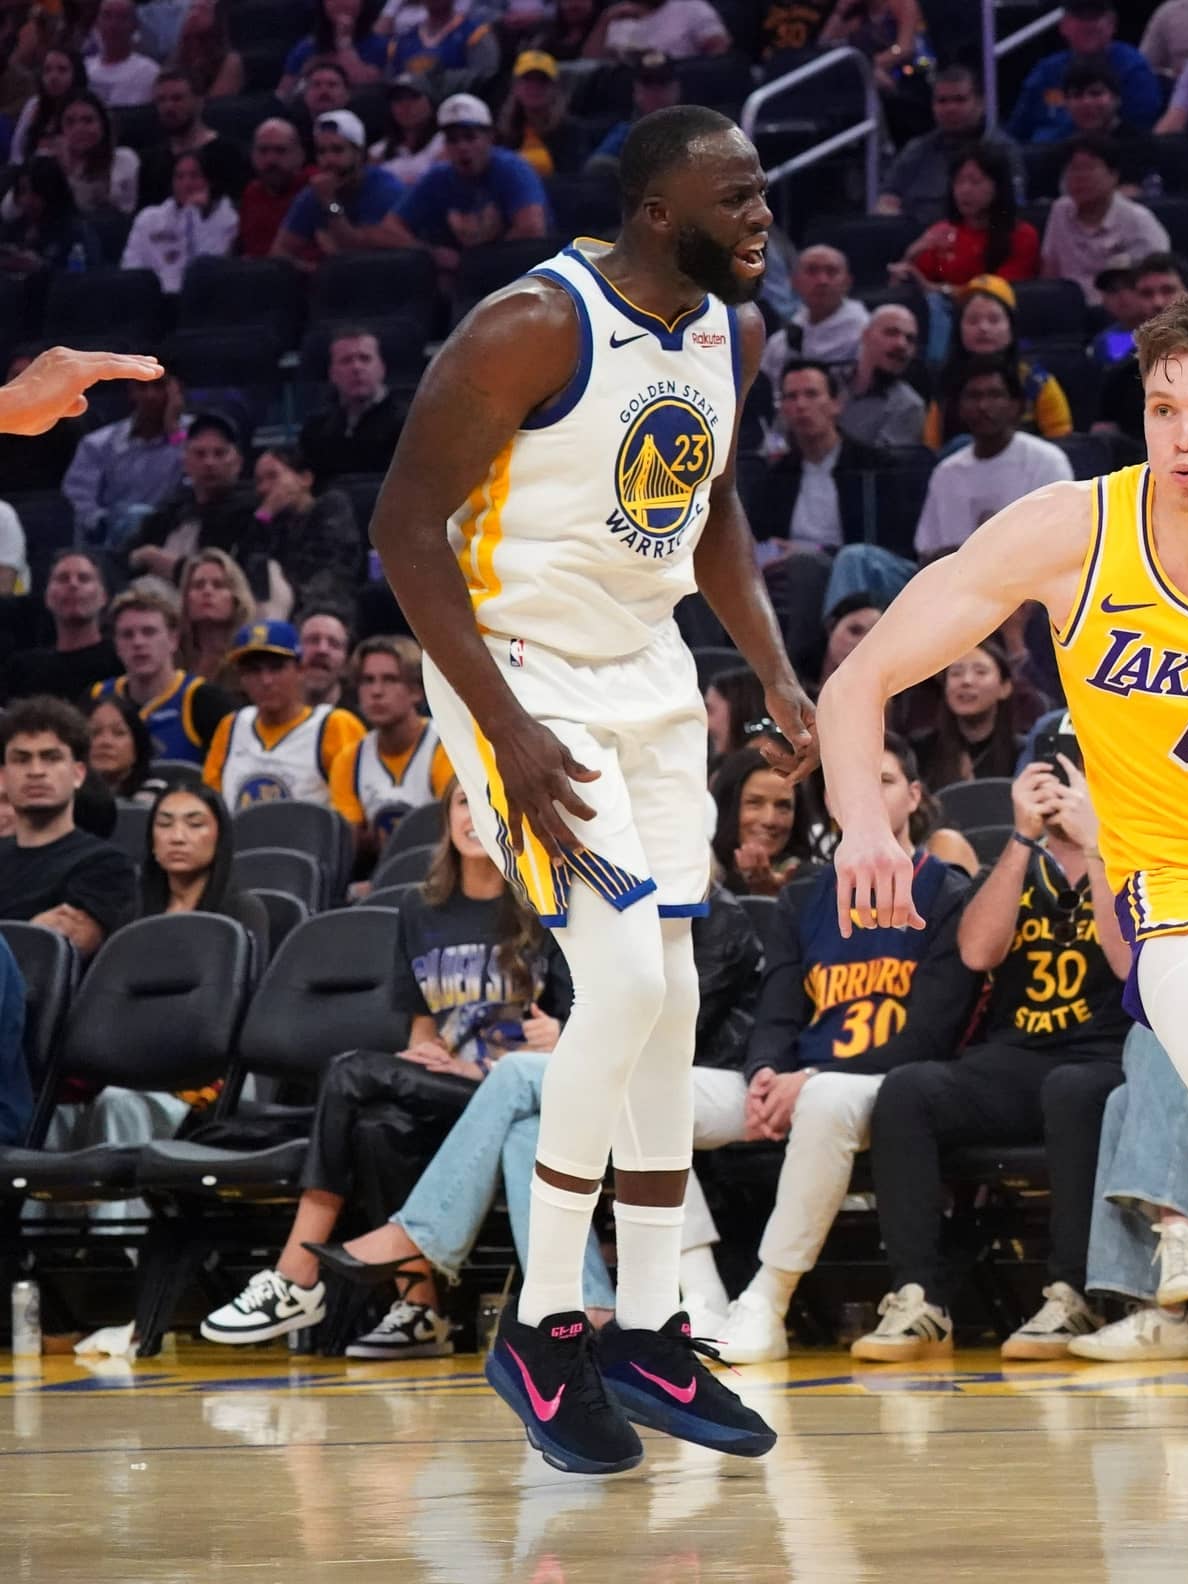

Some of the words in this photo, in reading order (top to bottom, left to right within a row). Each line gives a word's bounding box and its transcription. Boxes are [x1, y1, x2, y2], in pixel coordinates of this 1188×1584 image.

[692, 332, 726, 346] Rakuten
[620, 380, 677, 423] GOLDEN
[683, 385, 719, 427] STATE
[670, 434, 707, 472] 23
[1026, 950, 1087, 1002] 30
[832, 998, 907, 1059] 30
[1015, 999, 1093, 1033] STATE
